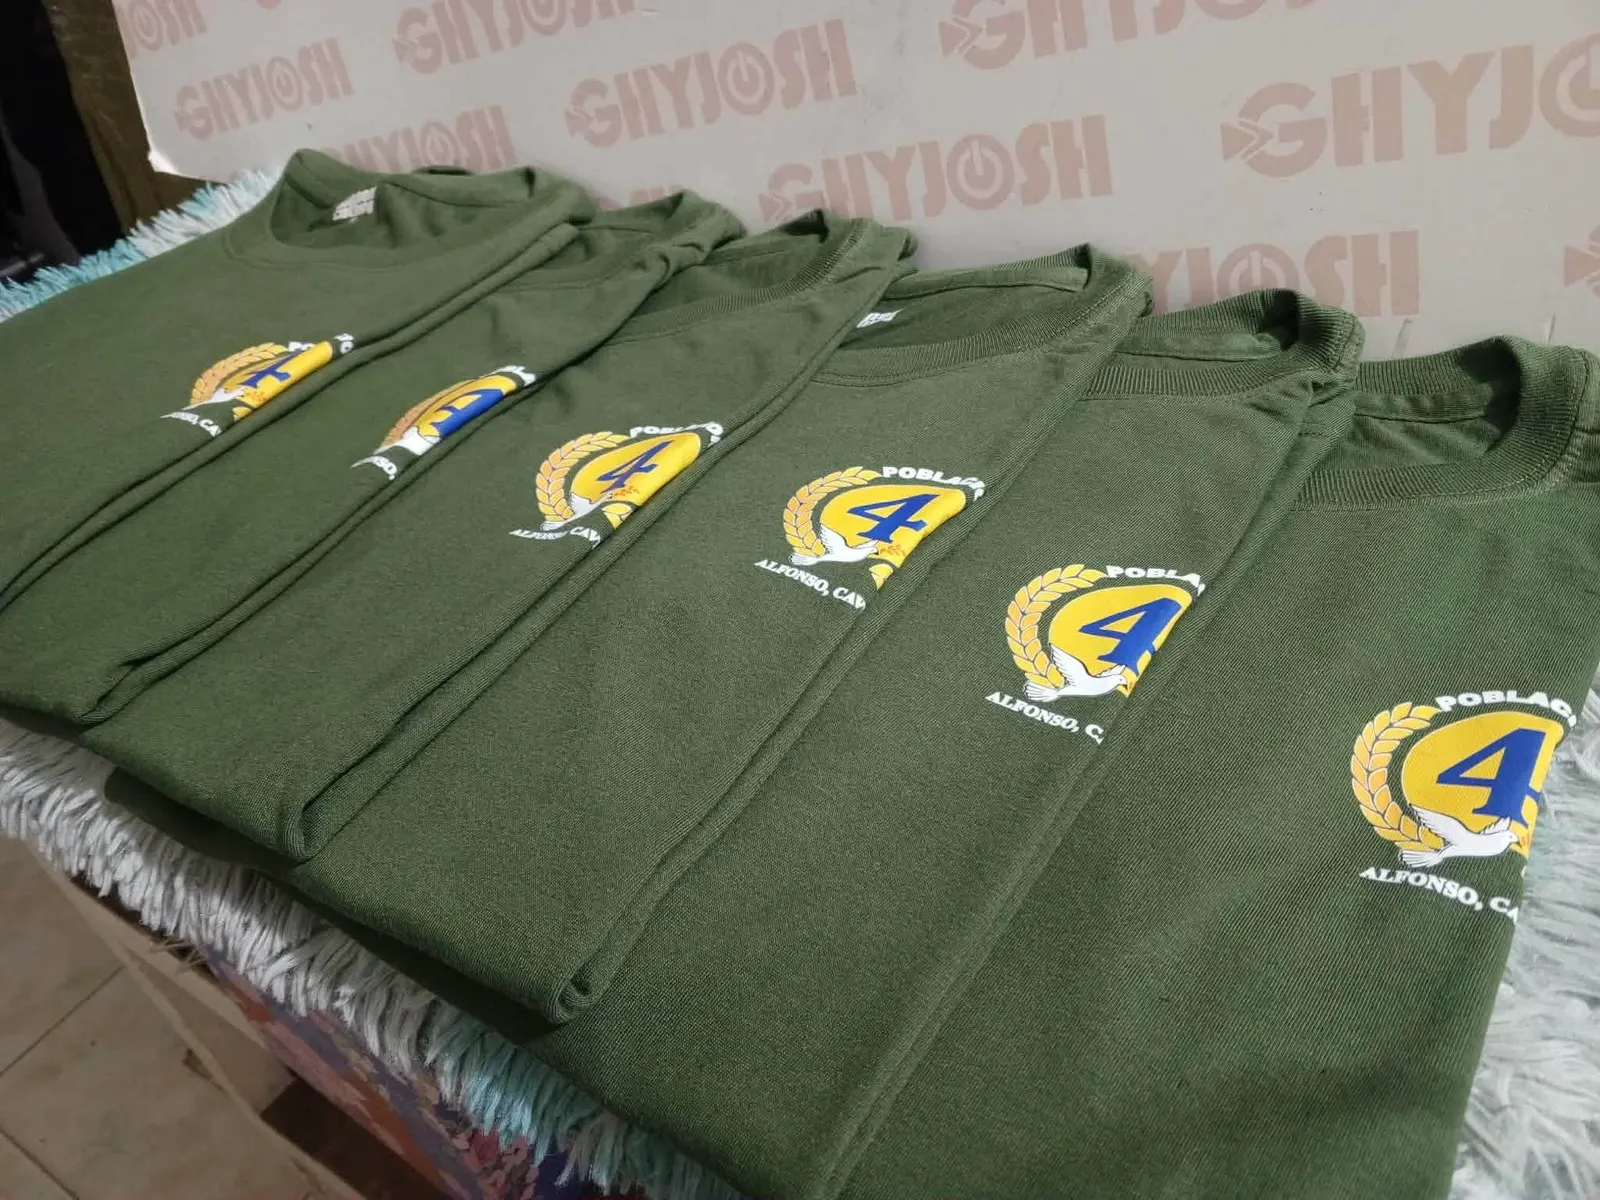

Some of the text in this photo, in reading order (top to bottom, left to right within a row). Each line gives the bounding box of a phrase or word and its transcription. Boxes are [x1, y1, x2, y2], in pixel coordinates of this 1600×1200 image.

[564, 18, 859, 149] GHYJOSH
[596, 439, 665, 494] 4
[847, 493, 941, 544] 4
[754, 559, 830, 597] ALFONSO,
[1077, 597, 1183, 677] 4
[985, 691, 1081, 733] ALFONSO,
[1436, 727, 1547, 828] 4
[1359, 867, 1483, 911] ALFONSO,
